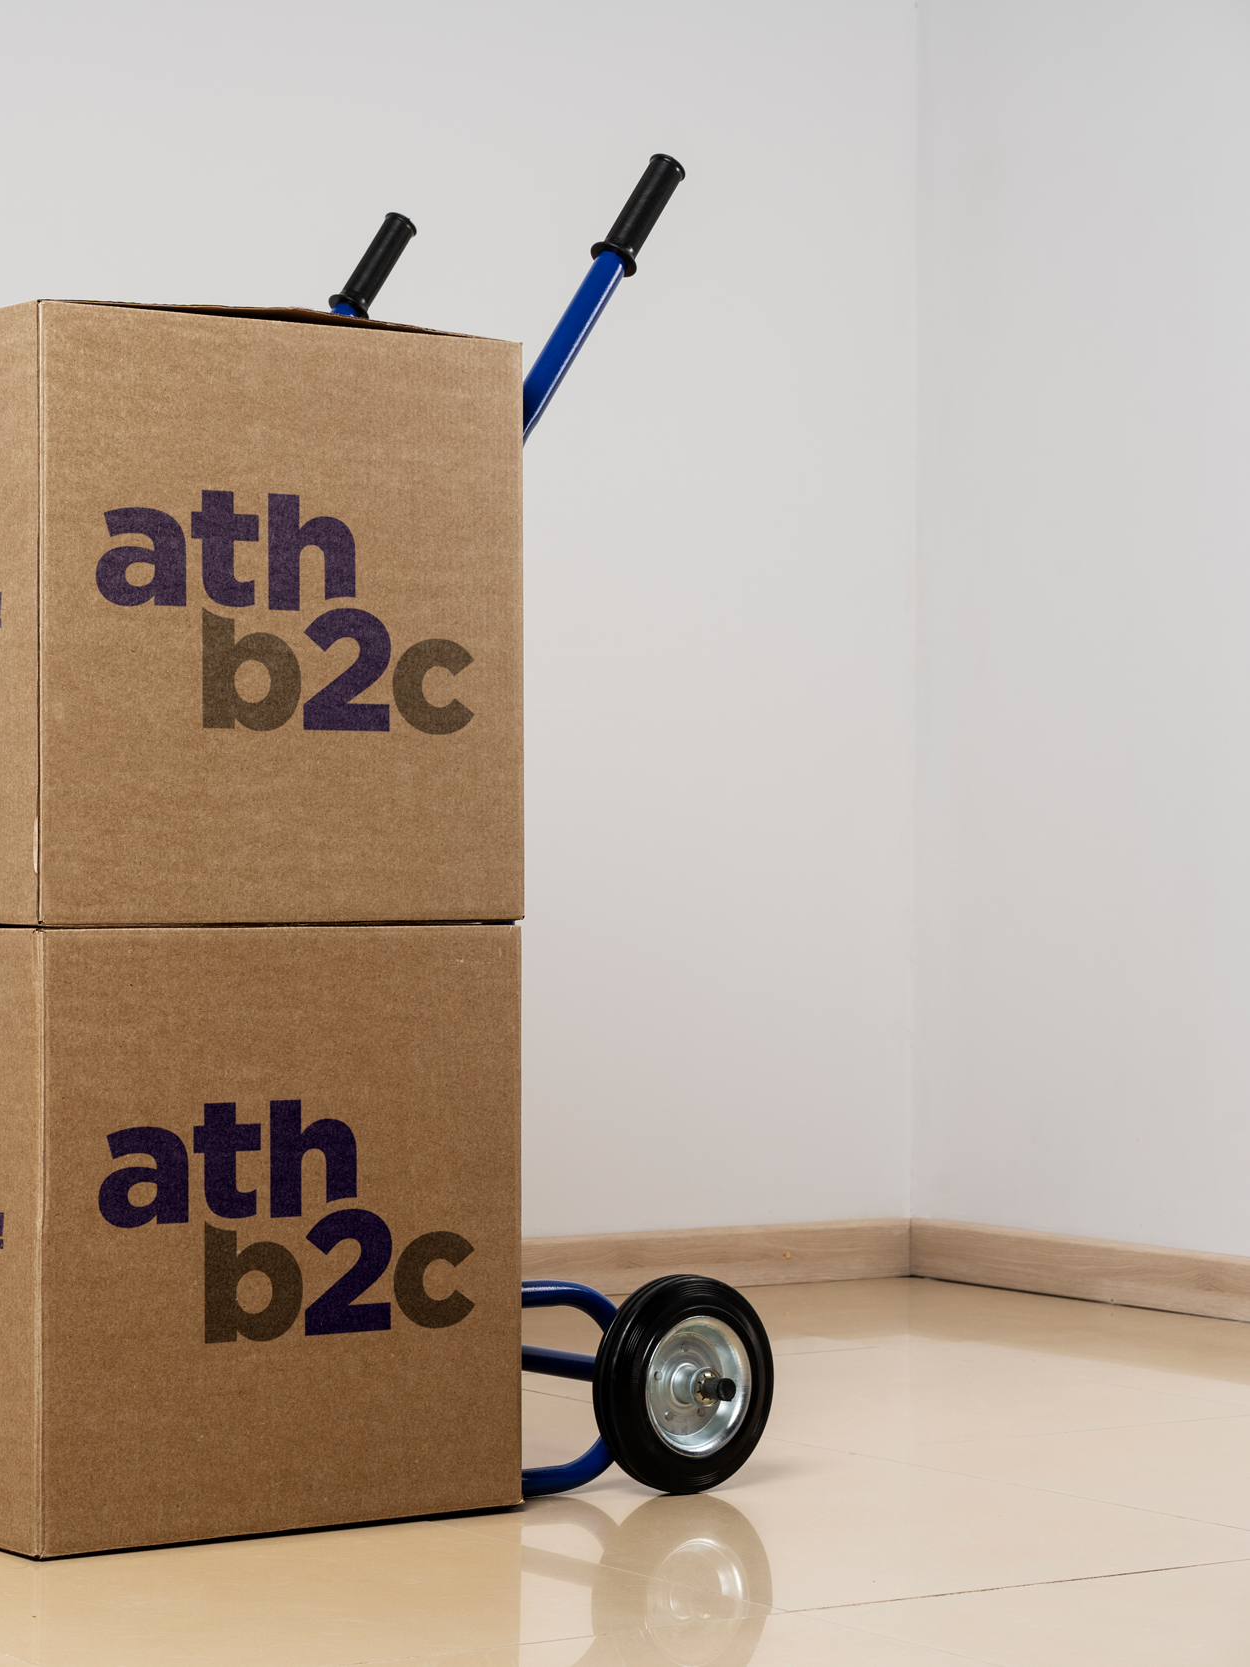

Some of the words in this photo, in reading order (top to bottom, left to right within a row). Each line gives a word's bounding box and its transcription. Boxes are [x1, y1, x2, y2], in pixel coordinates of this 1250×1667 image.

[95, 489, 357, 612] ath
[201, 606, 476, 736] b2c
[97, 1098, 358, 1230] ath
[203, 1207, 477, 1345] b2c
